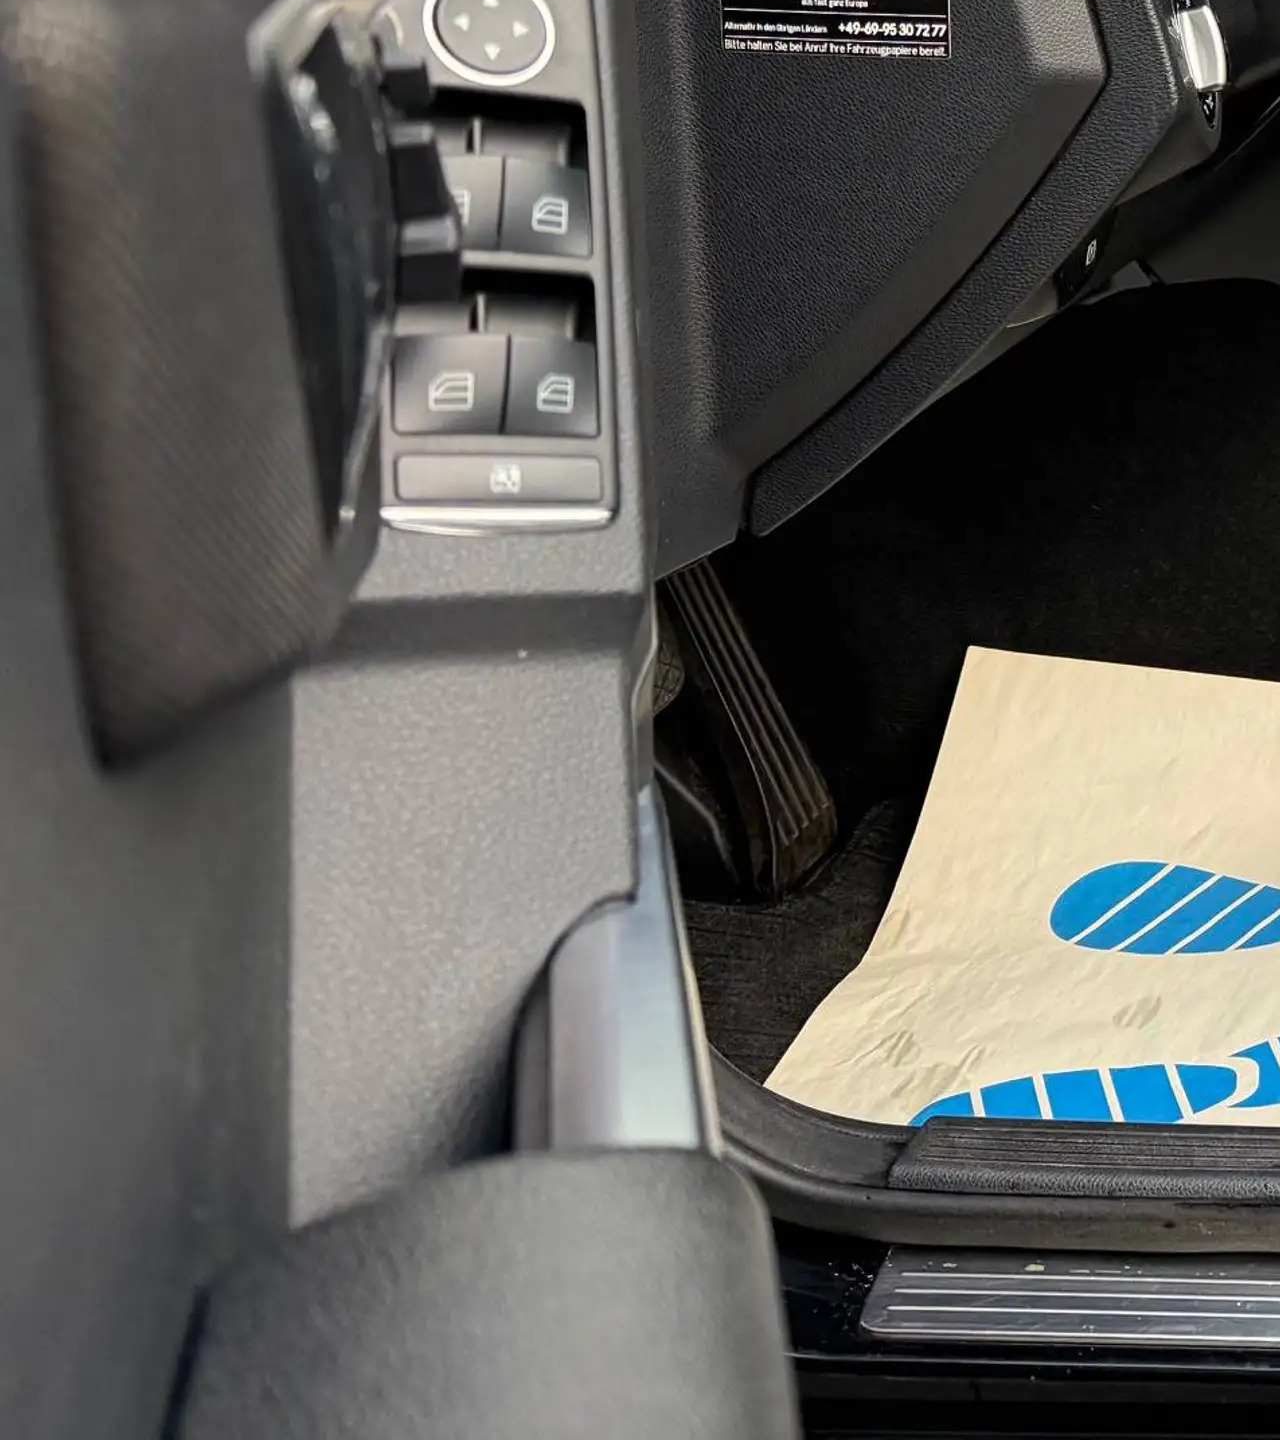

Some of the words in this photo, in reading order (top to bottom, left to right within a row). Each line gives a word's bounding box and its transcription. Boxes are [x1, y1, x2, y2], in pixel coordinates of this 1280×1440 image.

[844, 0, 868, 9] Europa
[724, 21, 756, 31] Alternativ
[838, 21, 897, 36] +49-69-95
[898, 23, 914, 37] 30
[915, 24, 931, 37] 72
[931, 24, 947, 38] 77
[724, 38, 746, 50] Bitte
[747, 39, 773, 51] halten
[774, 40, 788, 51] Sie
[789, 40, 803, 52] bei
[804, 41, 828, 53] Anruf
[829, 42, 845, 54] Ihre
[847, 42, 918, 58] Fahrzeugpapiere
